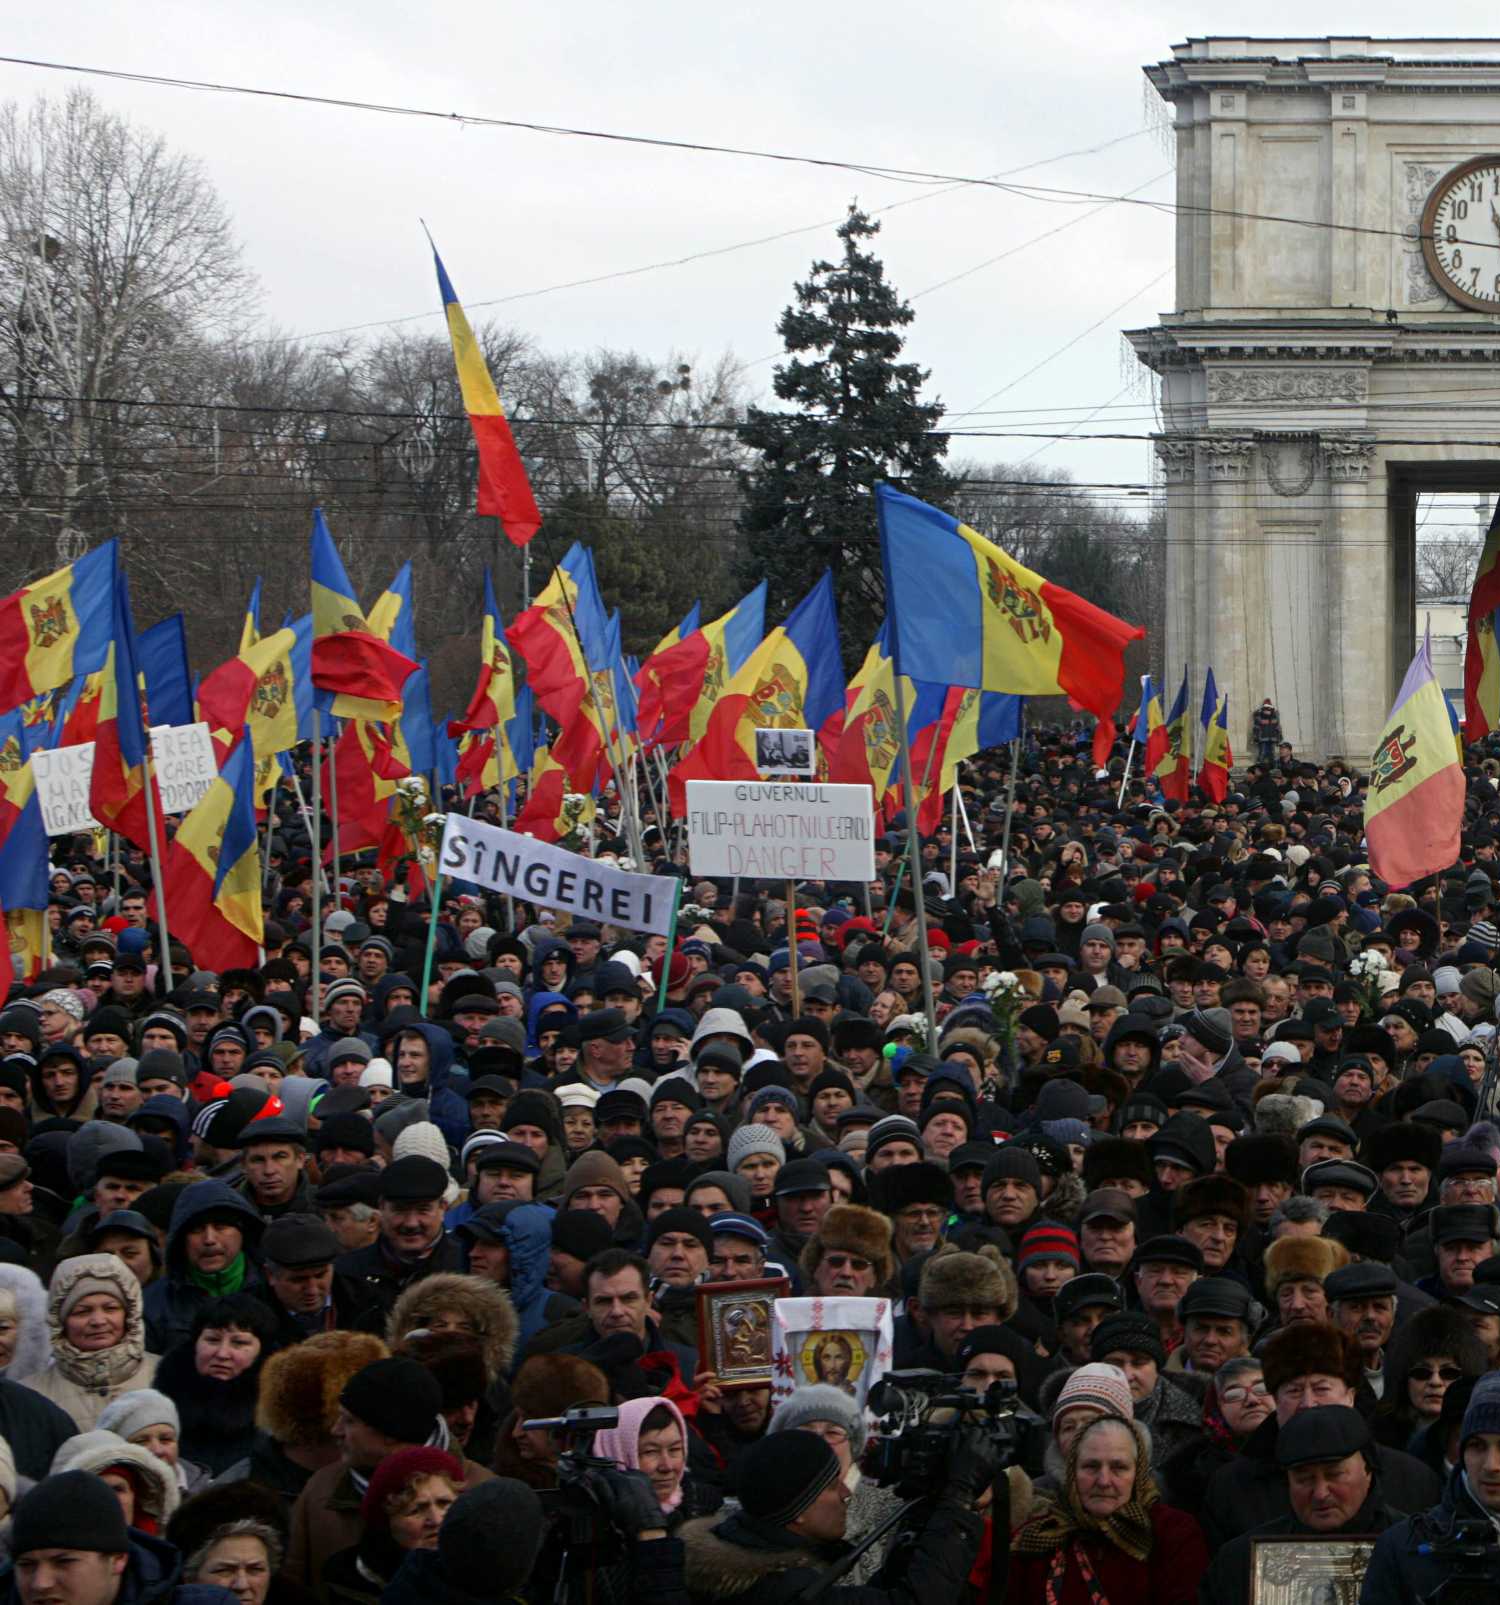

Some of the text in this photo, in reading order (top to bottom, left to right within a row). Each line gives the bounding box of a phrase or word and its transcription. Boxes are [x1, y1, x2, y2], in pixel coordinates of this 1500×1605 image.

[1470, 181, 1483, 202] 11
[1451, 200, 1468, 220] 10
[1446, 224, 1457, 244] 9
[1452, 249, 1463, 269] 8
[1470, 268, 1481, 287] 7
[38, 730, 204, 778] JOS EREA
[163, 756, 208, 780] CARE
[735, 785, 831, 803] GUVERNUL
[728, 844, 837, 878] DANGER
